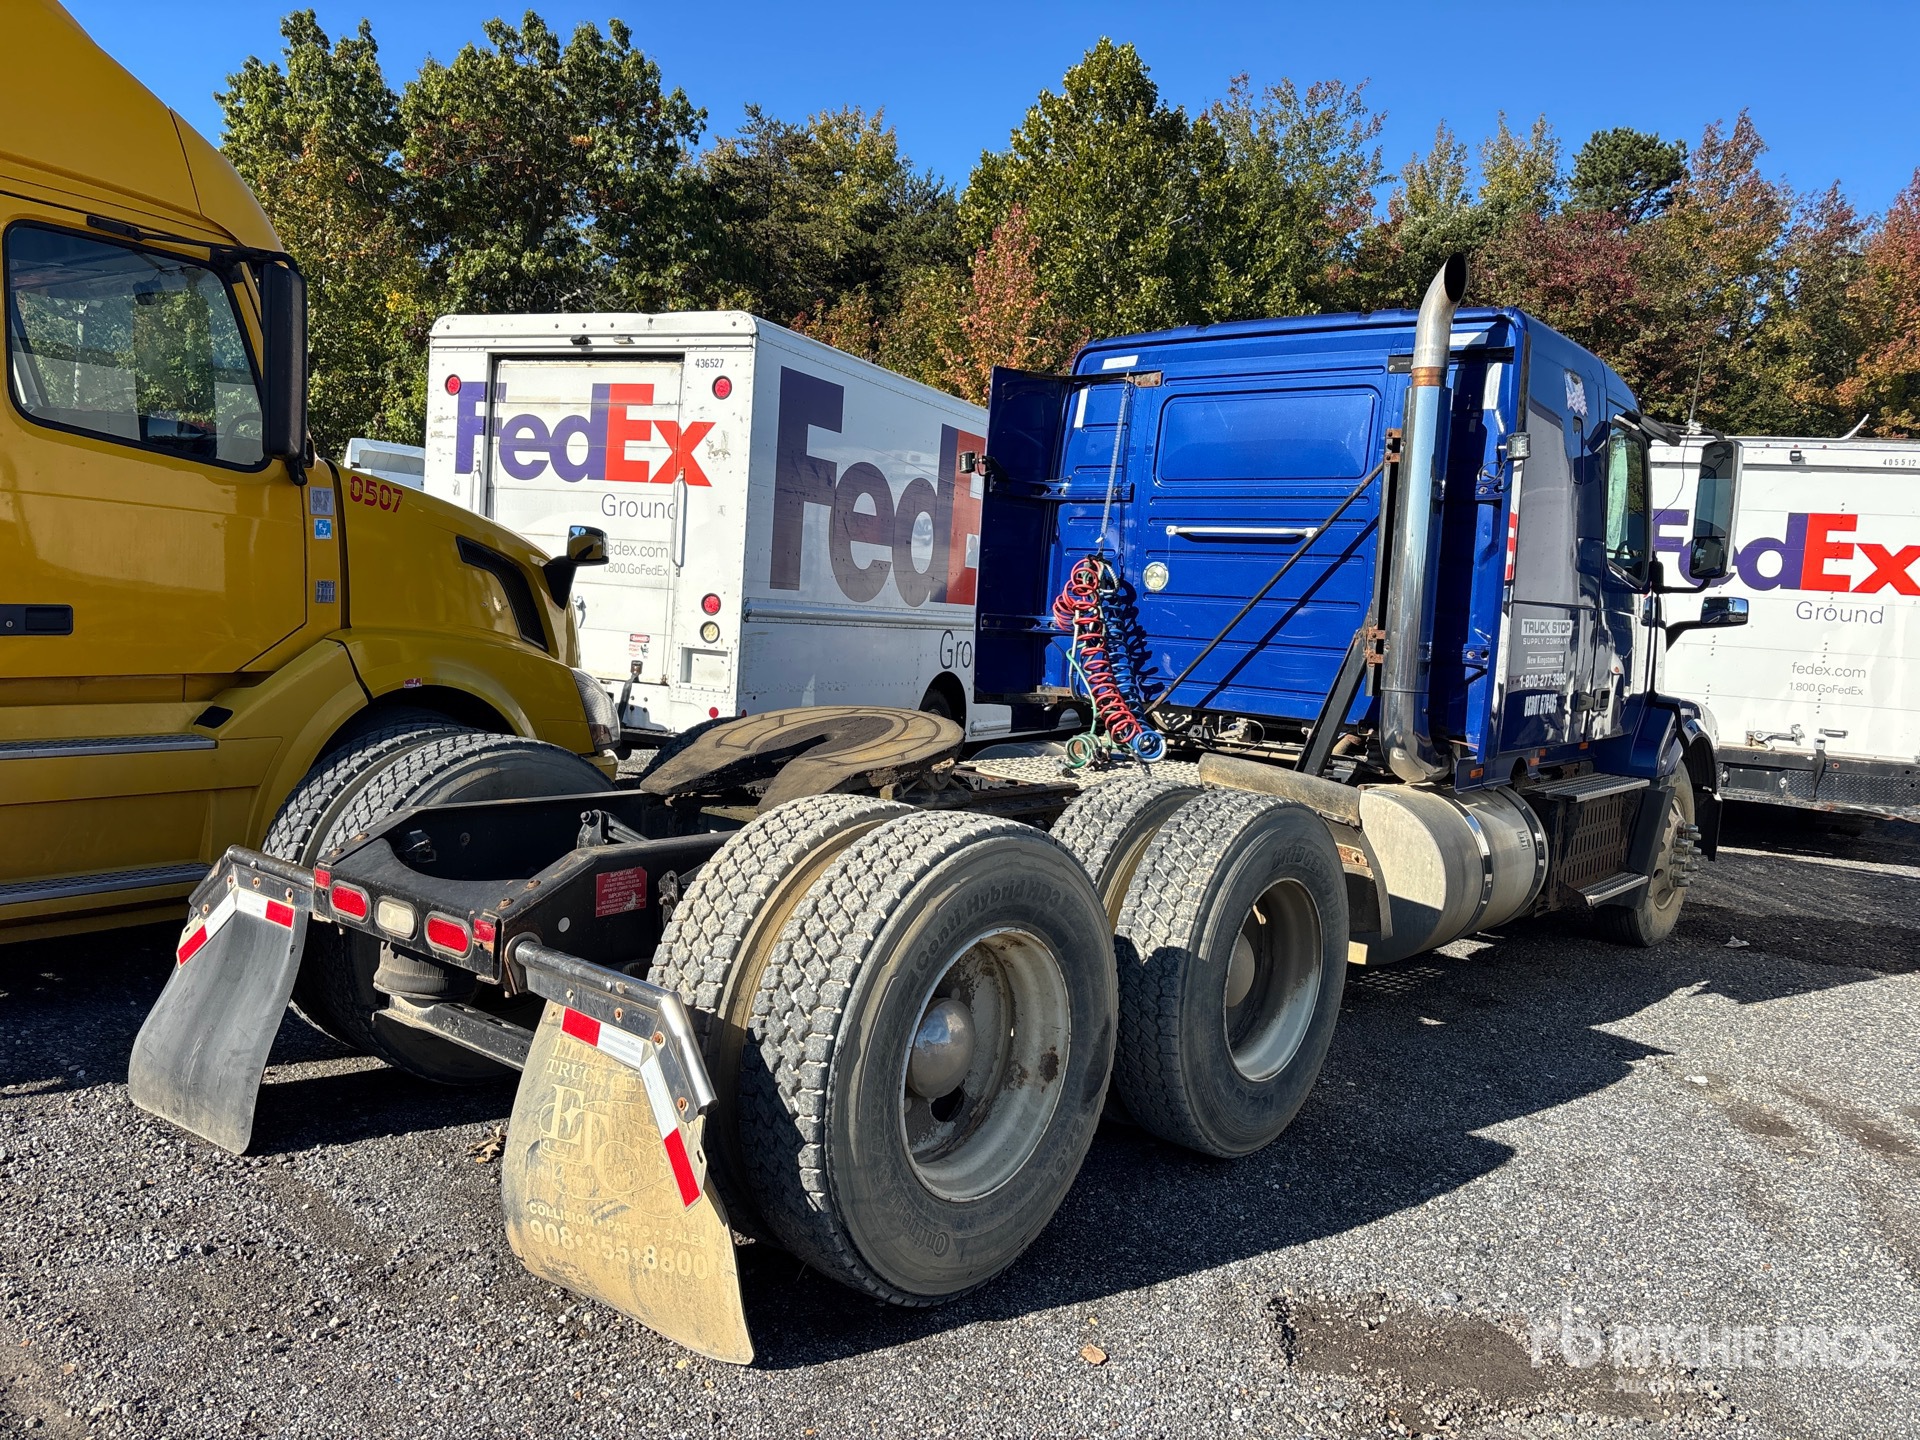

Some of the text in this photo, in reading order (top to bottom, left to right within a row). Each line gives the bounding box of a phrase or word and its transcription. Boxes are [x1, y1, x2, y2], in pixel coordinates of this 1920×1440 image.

[695, 358, 724, 369] 436527
[455, 381, 716, 488] FedEx
[1882, 458, 1918, 467] 405512
[350, 475, 404, 513] 0507
[609, 541, 669, 559] edex.com
[1795, 600, 1884, 625] Ground
[1523, 621, 1571, 634] TRUCK STOP
[1791, 661, 1867, 679] fedex.com
[1789, 681, 1864, 696] 1.800.GoFedEx
[966, 879, 1026, 916] Hybrid
[529, 1202, 595, 1228] COLLISION
[664, 1227, 707, 1249] SALES
